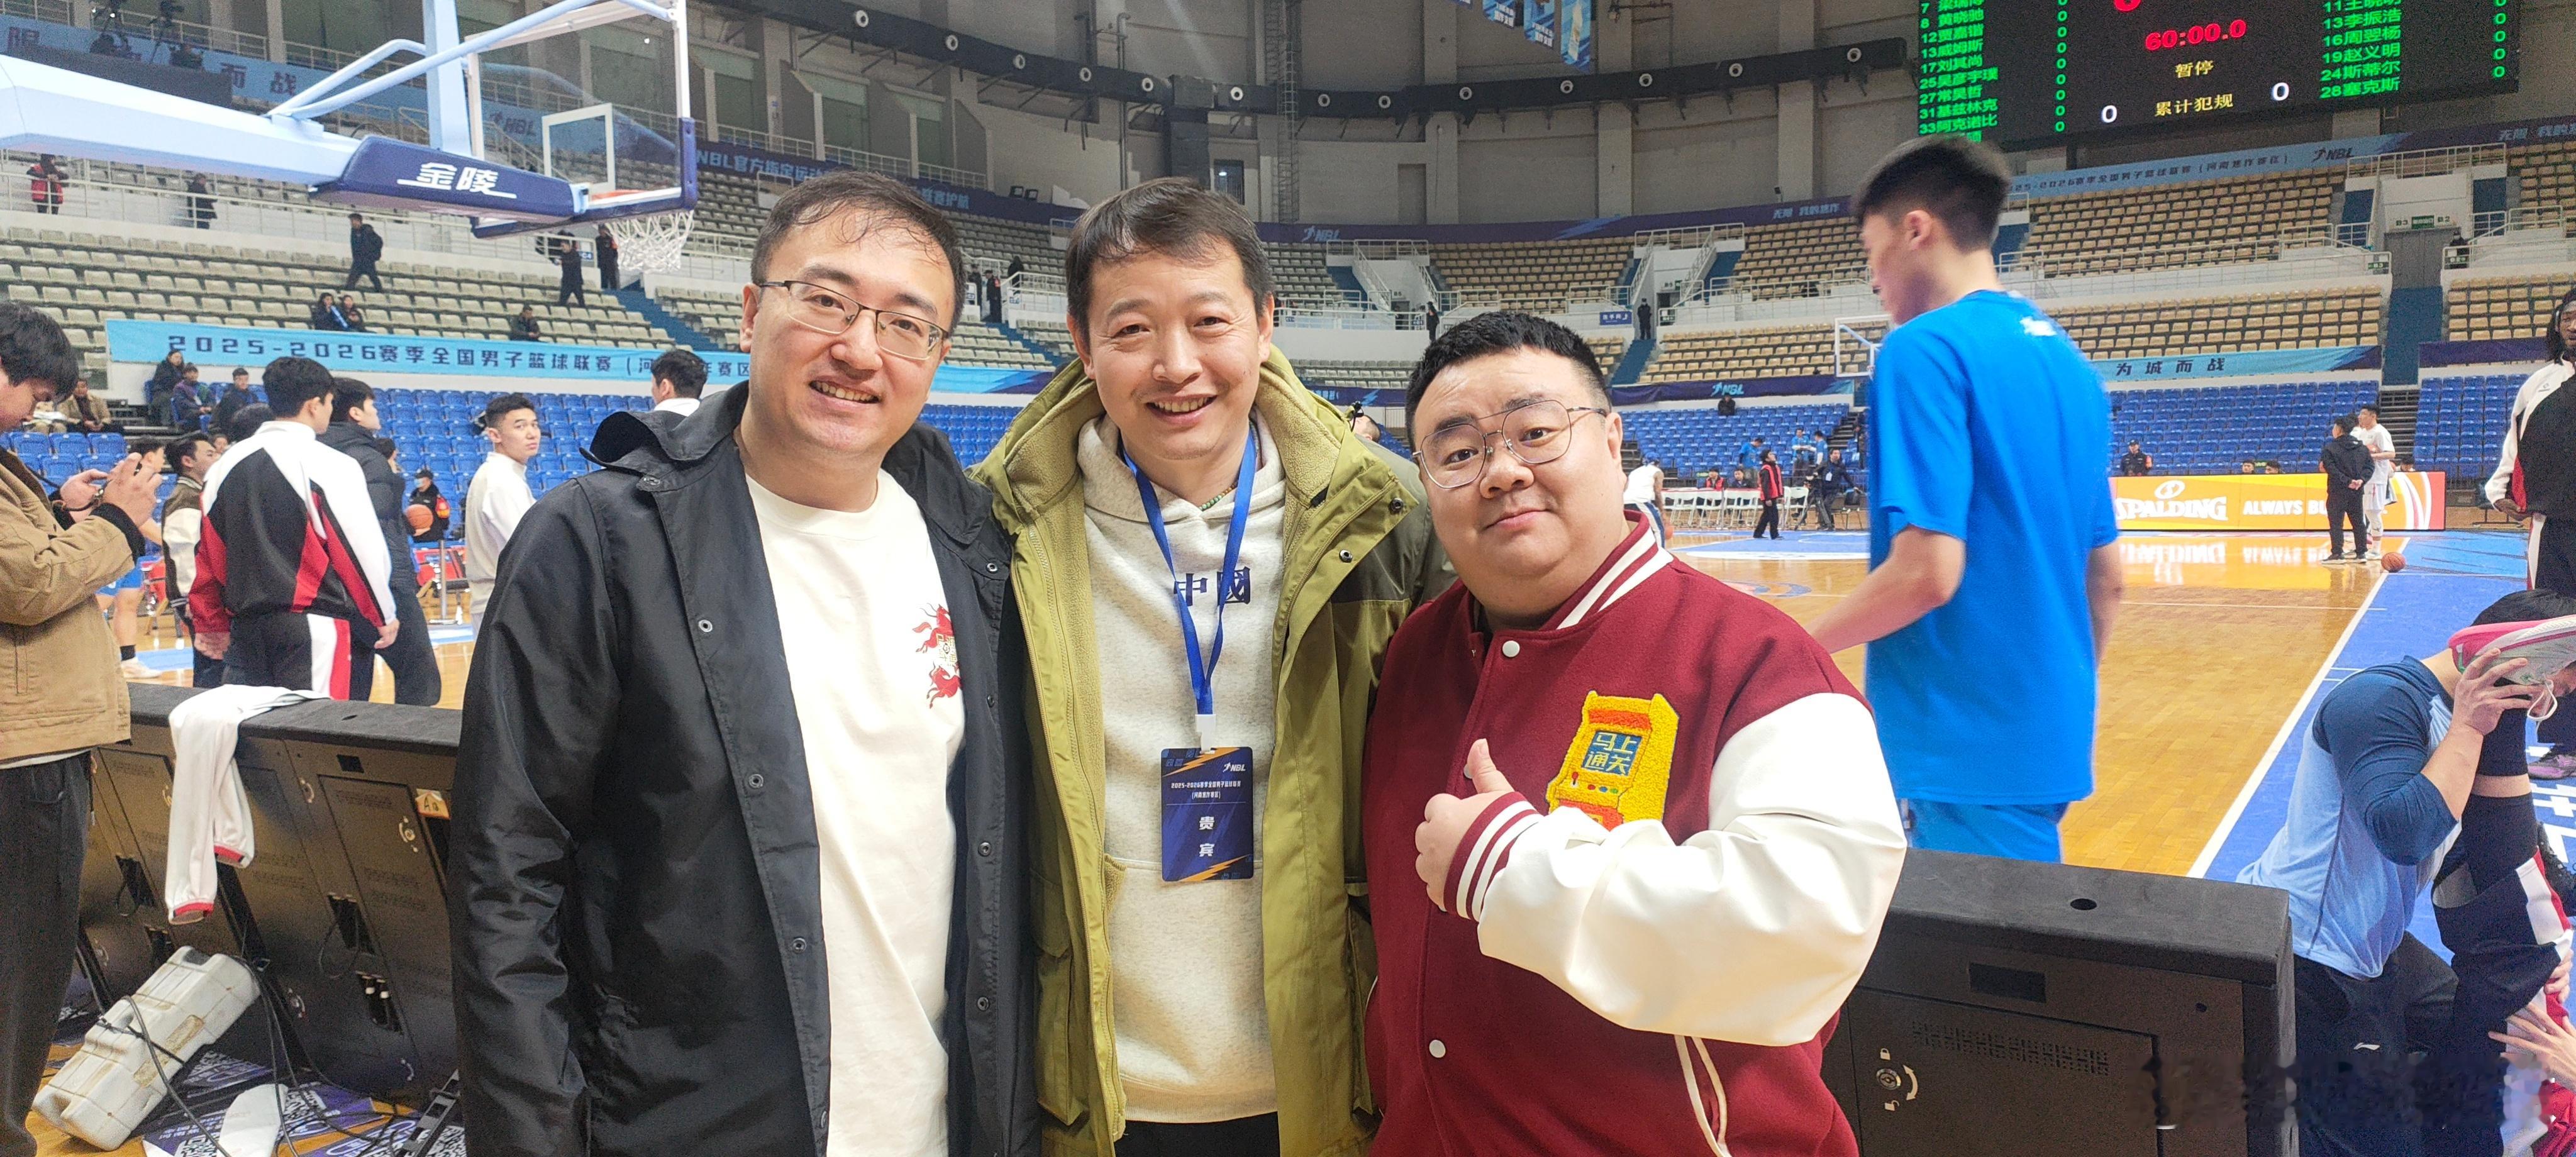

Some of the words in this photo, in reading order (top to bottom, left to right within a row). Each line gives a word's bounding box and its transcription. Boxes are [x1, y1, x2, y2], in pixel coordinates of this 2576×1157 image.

[1921, 3, 1929, 14] 7
[1920, 18, 1930, 29] 8
[2145, 19, 2246, 50] 60:00.0
[2175, 60, 2214, 78] 暂停
[2101, 105, 2118, 123] 0
[2155, 94, 2233, 116] 累计犯规
[2272, 82, 2289, 101] 0
[397, 162, 517, 199] 金陵
[2116, 358, 2225, 376] 为城而战
[1721, 384, 1745, 396] NBL
[2116, 496, 2228, 521] SPALDING
[2243, 500, 2304, 516] ALWAYS
[1592, 732, 1637, 755] 马上
[1230, 763, 1246, 772] NBL
[1584, 751, 1631, 775] 通关
